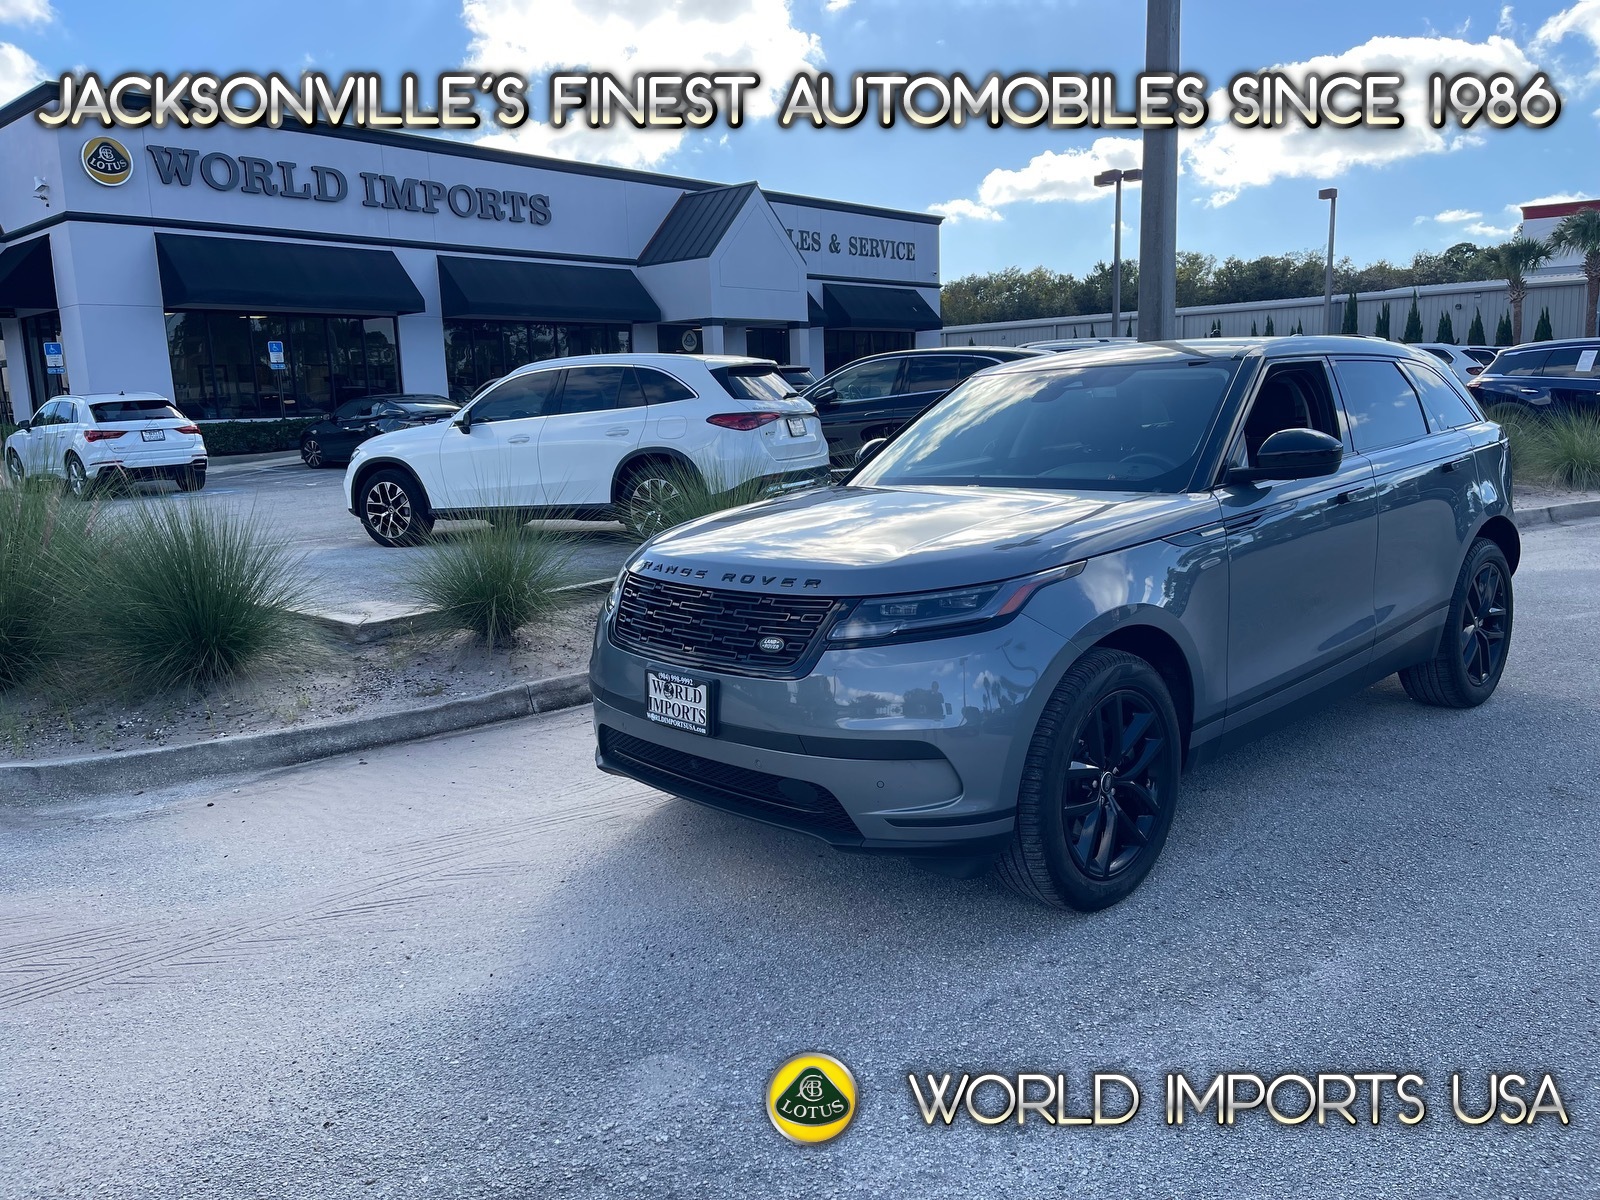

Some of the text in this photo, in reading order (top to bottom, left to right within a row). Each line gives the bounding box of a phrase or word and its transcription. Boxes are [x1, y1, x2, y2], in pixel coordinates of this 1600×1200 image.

[90, 158, 127, 171] LOTUS
[146, 145, 552, 225] WORLD IMPORTS
[828, 233, 841, 254] &
[848, 235, 916, 261] SERVICE
[643, 561, 821, 588] RANGE ROVER
[652, 679, 702, 703] WORLD
[649, 697, 706, 725] IMPORTS
